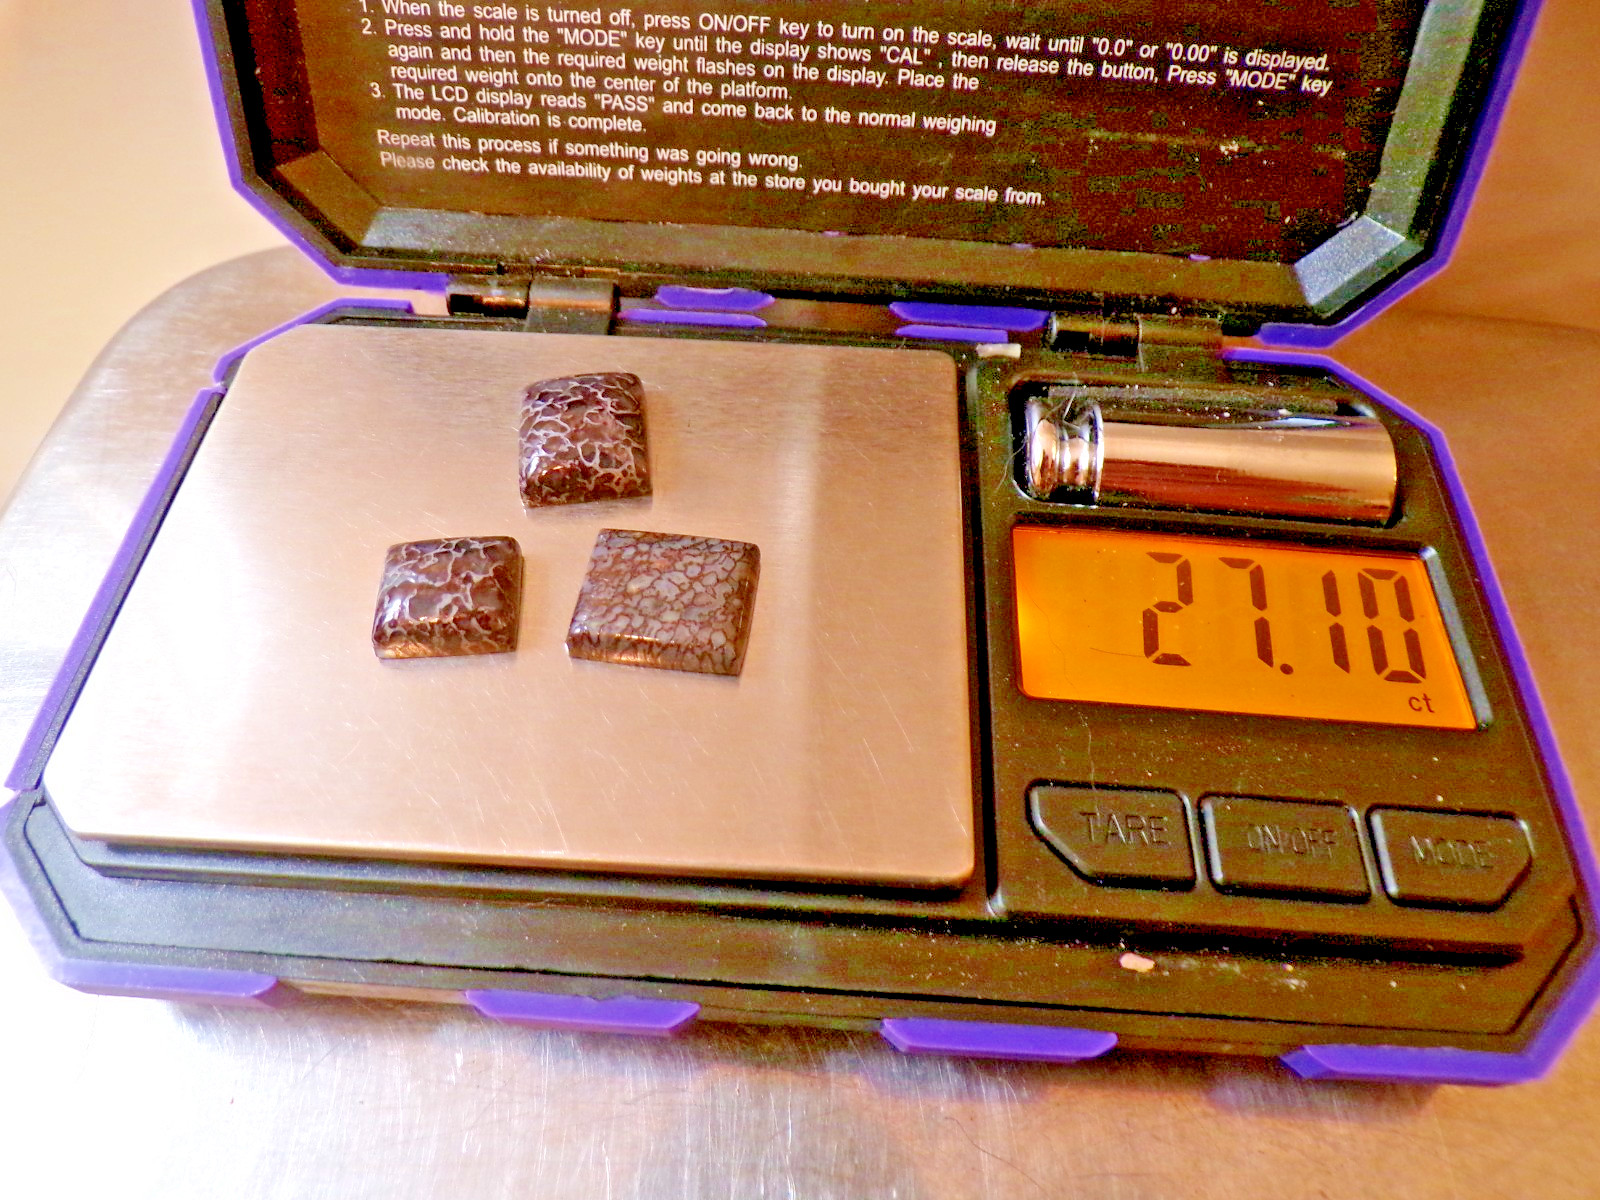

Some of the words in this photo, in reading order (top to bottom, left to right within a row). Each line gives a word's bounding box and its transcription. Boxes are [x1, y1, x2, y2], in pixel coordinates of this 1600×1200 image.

[361, 18, 376, 35] 2.
[385, 19, 431, 38] Press
[440, 23, 471, 40] and
[480, 24, 514, 42] hold
[523, 27, 549, 44] the
[557, 27, 627, 48] "MODE"
[635, 31, 664, 53] key
[673, 33, 708, 51] until
[716, 36, 741, 54] the
[750, 38, 808, 60] display
[817, 45, 870, 62] shows
[952, 51, 988, 70] then
[997, 55, 1059, 74] release
[1067, 58, 1093, 76] the
[1167, 65, 1216, 85] Press
[1226, 69, 1295, 91] "MODE"
[1301, 74, 1332, 97] key
[384, 0, 430, 16] When
[439, 1, 464, 18] the
[474, 3, 517, 20] scale
[526, 4, 539, 21] is
[547, 5, 601, 25] turned
[610, 9, 635, 29] off,
[644, 13, 690, 31] press
[699, 13, 771, 33] ON/OFF
[779, 18, 809, 39] key
[817, 21, 833, 37] to
[842, 22, 874, 40] turn
[883, 26, 904, 42] on
[912, 27, 939, 44] the
[948, 30, 996, 49] scale,
[1006, 34, 1040, 50] wait
[1048, 35, 1084, 54] until
[1092, 38, 1132, 56] "0.0"
[1140, 43, 1158, 58] or
[1166, 42, 1217, 62] "0.00"
[1225, 47, 1238, 65] is
[1246, 49, 1330, 72] displayed.
[388, 45, 432, 62] again
[442, 45, 471, 62] and
[480, 46, 515, 64] then
[523, 48, 549, 65] the
[558, 50, 625, 71] required
[634, 55, 688, 75] weight
[697, 56, 755, 76] flashes
[764, 63, 784, 79] on
[792, 62, 820, 80] the
[828, 65, 888, 87] display.
[898, 68, 944, 88] Place
[952, 72, 979, 91] the
[391, 64, 457, 84] required
[465, 68, 518, 87] weight
[526, 73, 562, 88] onto
[571, 72, 595, 89] the
[604, 76, 655, 93] center
[664, 77, 679, 93] of
[687, 79, 712, 95] the
[721, 80, 792, 100] platform.
[370, 83, 385, 99] 3.
[393, 83, 424, 100] The
[432, 85, 468, 102] LCD
[476, 88, 532, 109] display
[540, 91, 586, 109] reads
[595, 93, 654, 112] "PASS"
[663, 98, 693, 116] and
[702, 102, 746, 118] come
[755, 102, 793, 120] back
[802, 106, 817, 122] to
[824, 106, 850, 124] the
[859, 110, 915, 128] normal
[923, 113, 996, 137] weighing
[396, 105, 445, 122] mode.
[454, 107, 539, 128] Calibration
[548, 110, 561, 128] is
[569, 113, 646, 134] complete.
[377, 129, 435, 149] Repeat
[442, 132, 470, 150] this
[479, 137, 541, 154] process
[549, 139, 558, 156] if
[566, 140, 648, 162] something
[657, 145, 688, 162] was
[697, 148, 740, 168] going
[748, 151, 802, 172] wrong.
[379, 151, 434, 170] Please
[442, 154, 488, 173] check
[496, 157, 520, 175] the
[529, 160, 611, 182] availability
[618, 165, 634, 181] of
[641, 166, 701, 185] weights
[710, 169, 725, 185] at
[733, 170, 758, 188] the
[765, 172, 805, 191] store
[813, 176, 841, 195] you
[850, 177, 906, 199] bought
[912, 183, 949, 201] your
[955, 183, 998, 202] scale
[1005, 187, 1045, 205] from.
[1141, 551, 1427, 684] 27.10
[1408, 694, 1434, 714] ct
[1079, 810, 1170, 848] TARE
[1410, 835, 1494, 870] MODE
